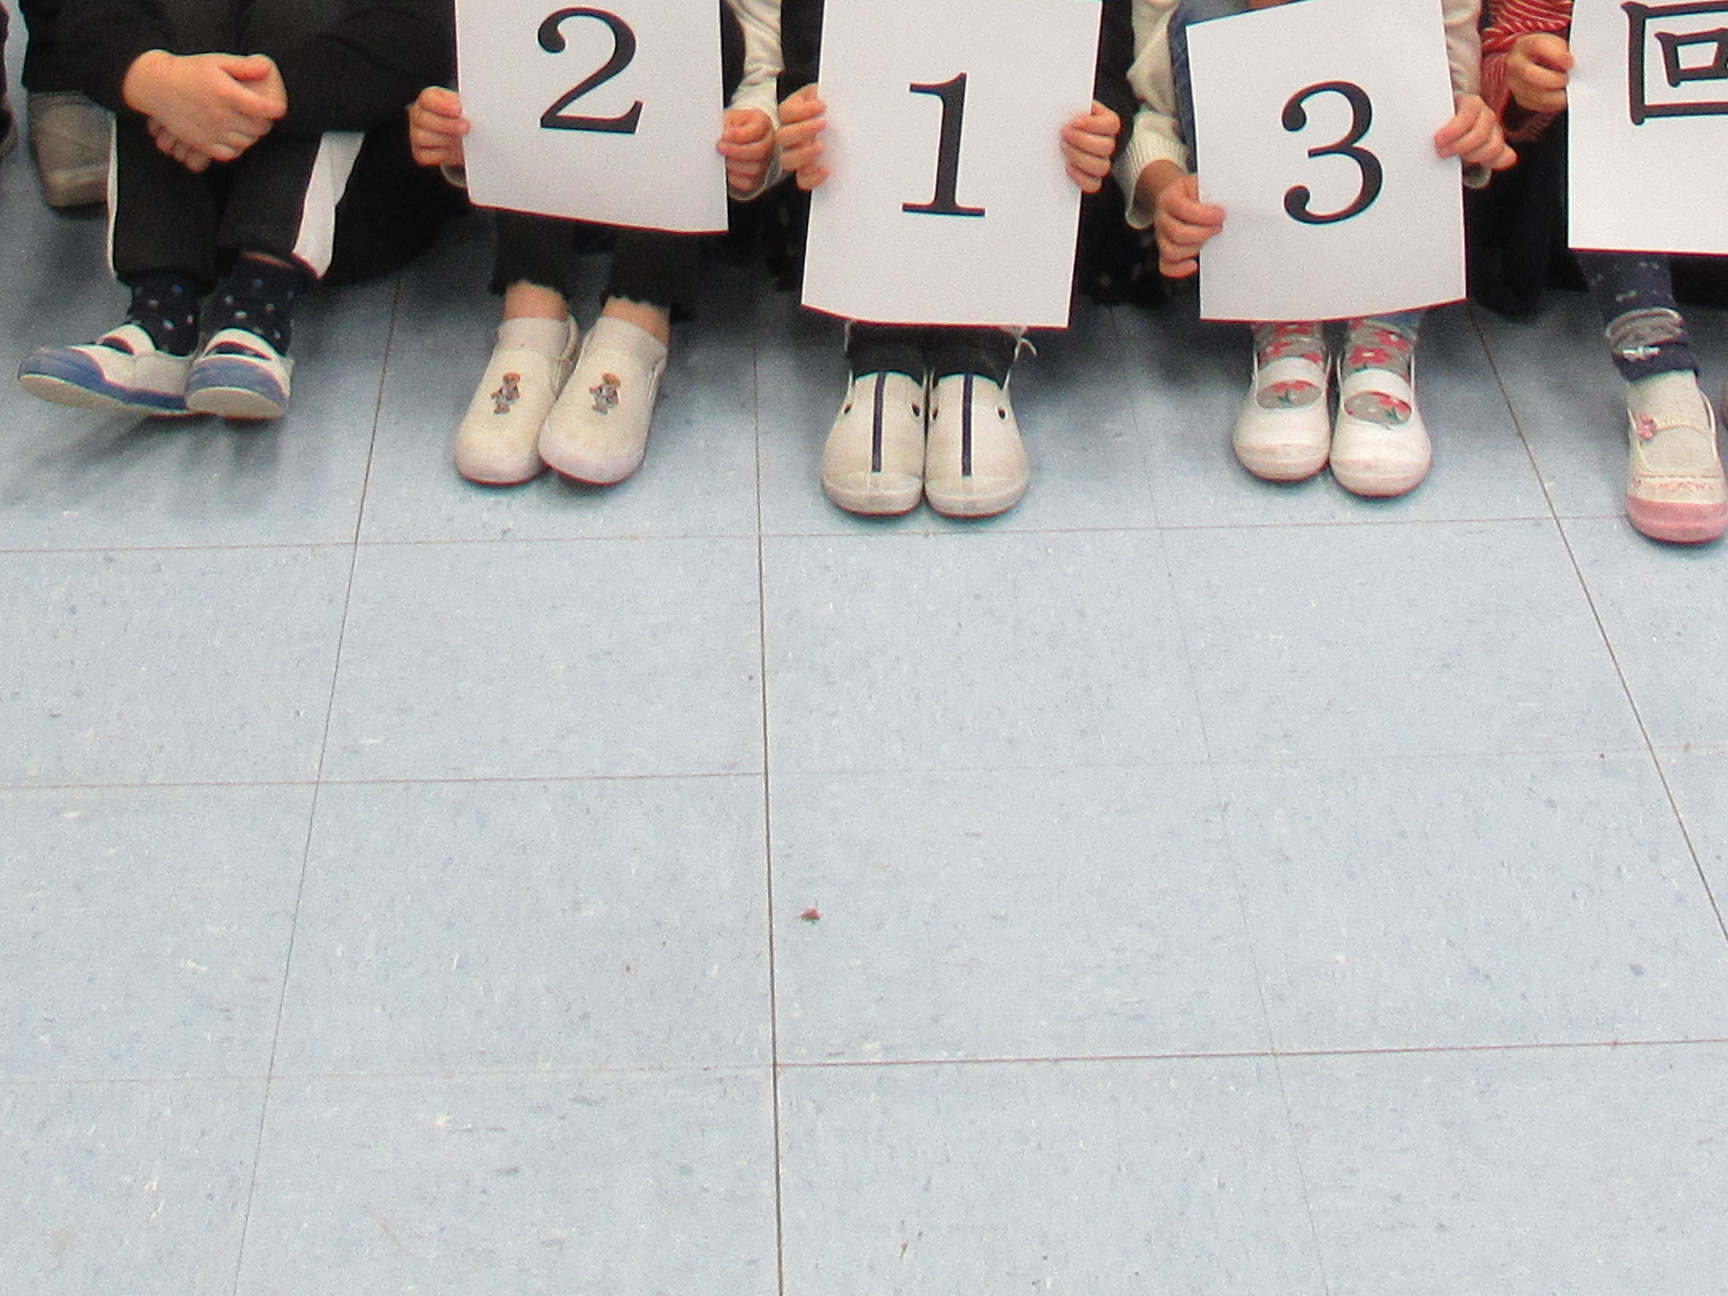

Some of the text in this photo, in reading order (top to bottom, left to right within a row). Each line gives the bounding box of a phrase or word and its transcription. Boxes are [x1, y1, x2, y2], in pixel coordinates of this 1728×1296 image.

[534, 5, 644, 138] 2
[899, 70, 987, 218] 1
[1280, 79, 1385, 227] 3
